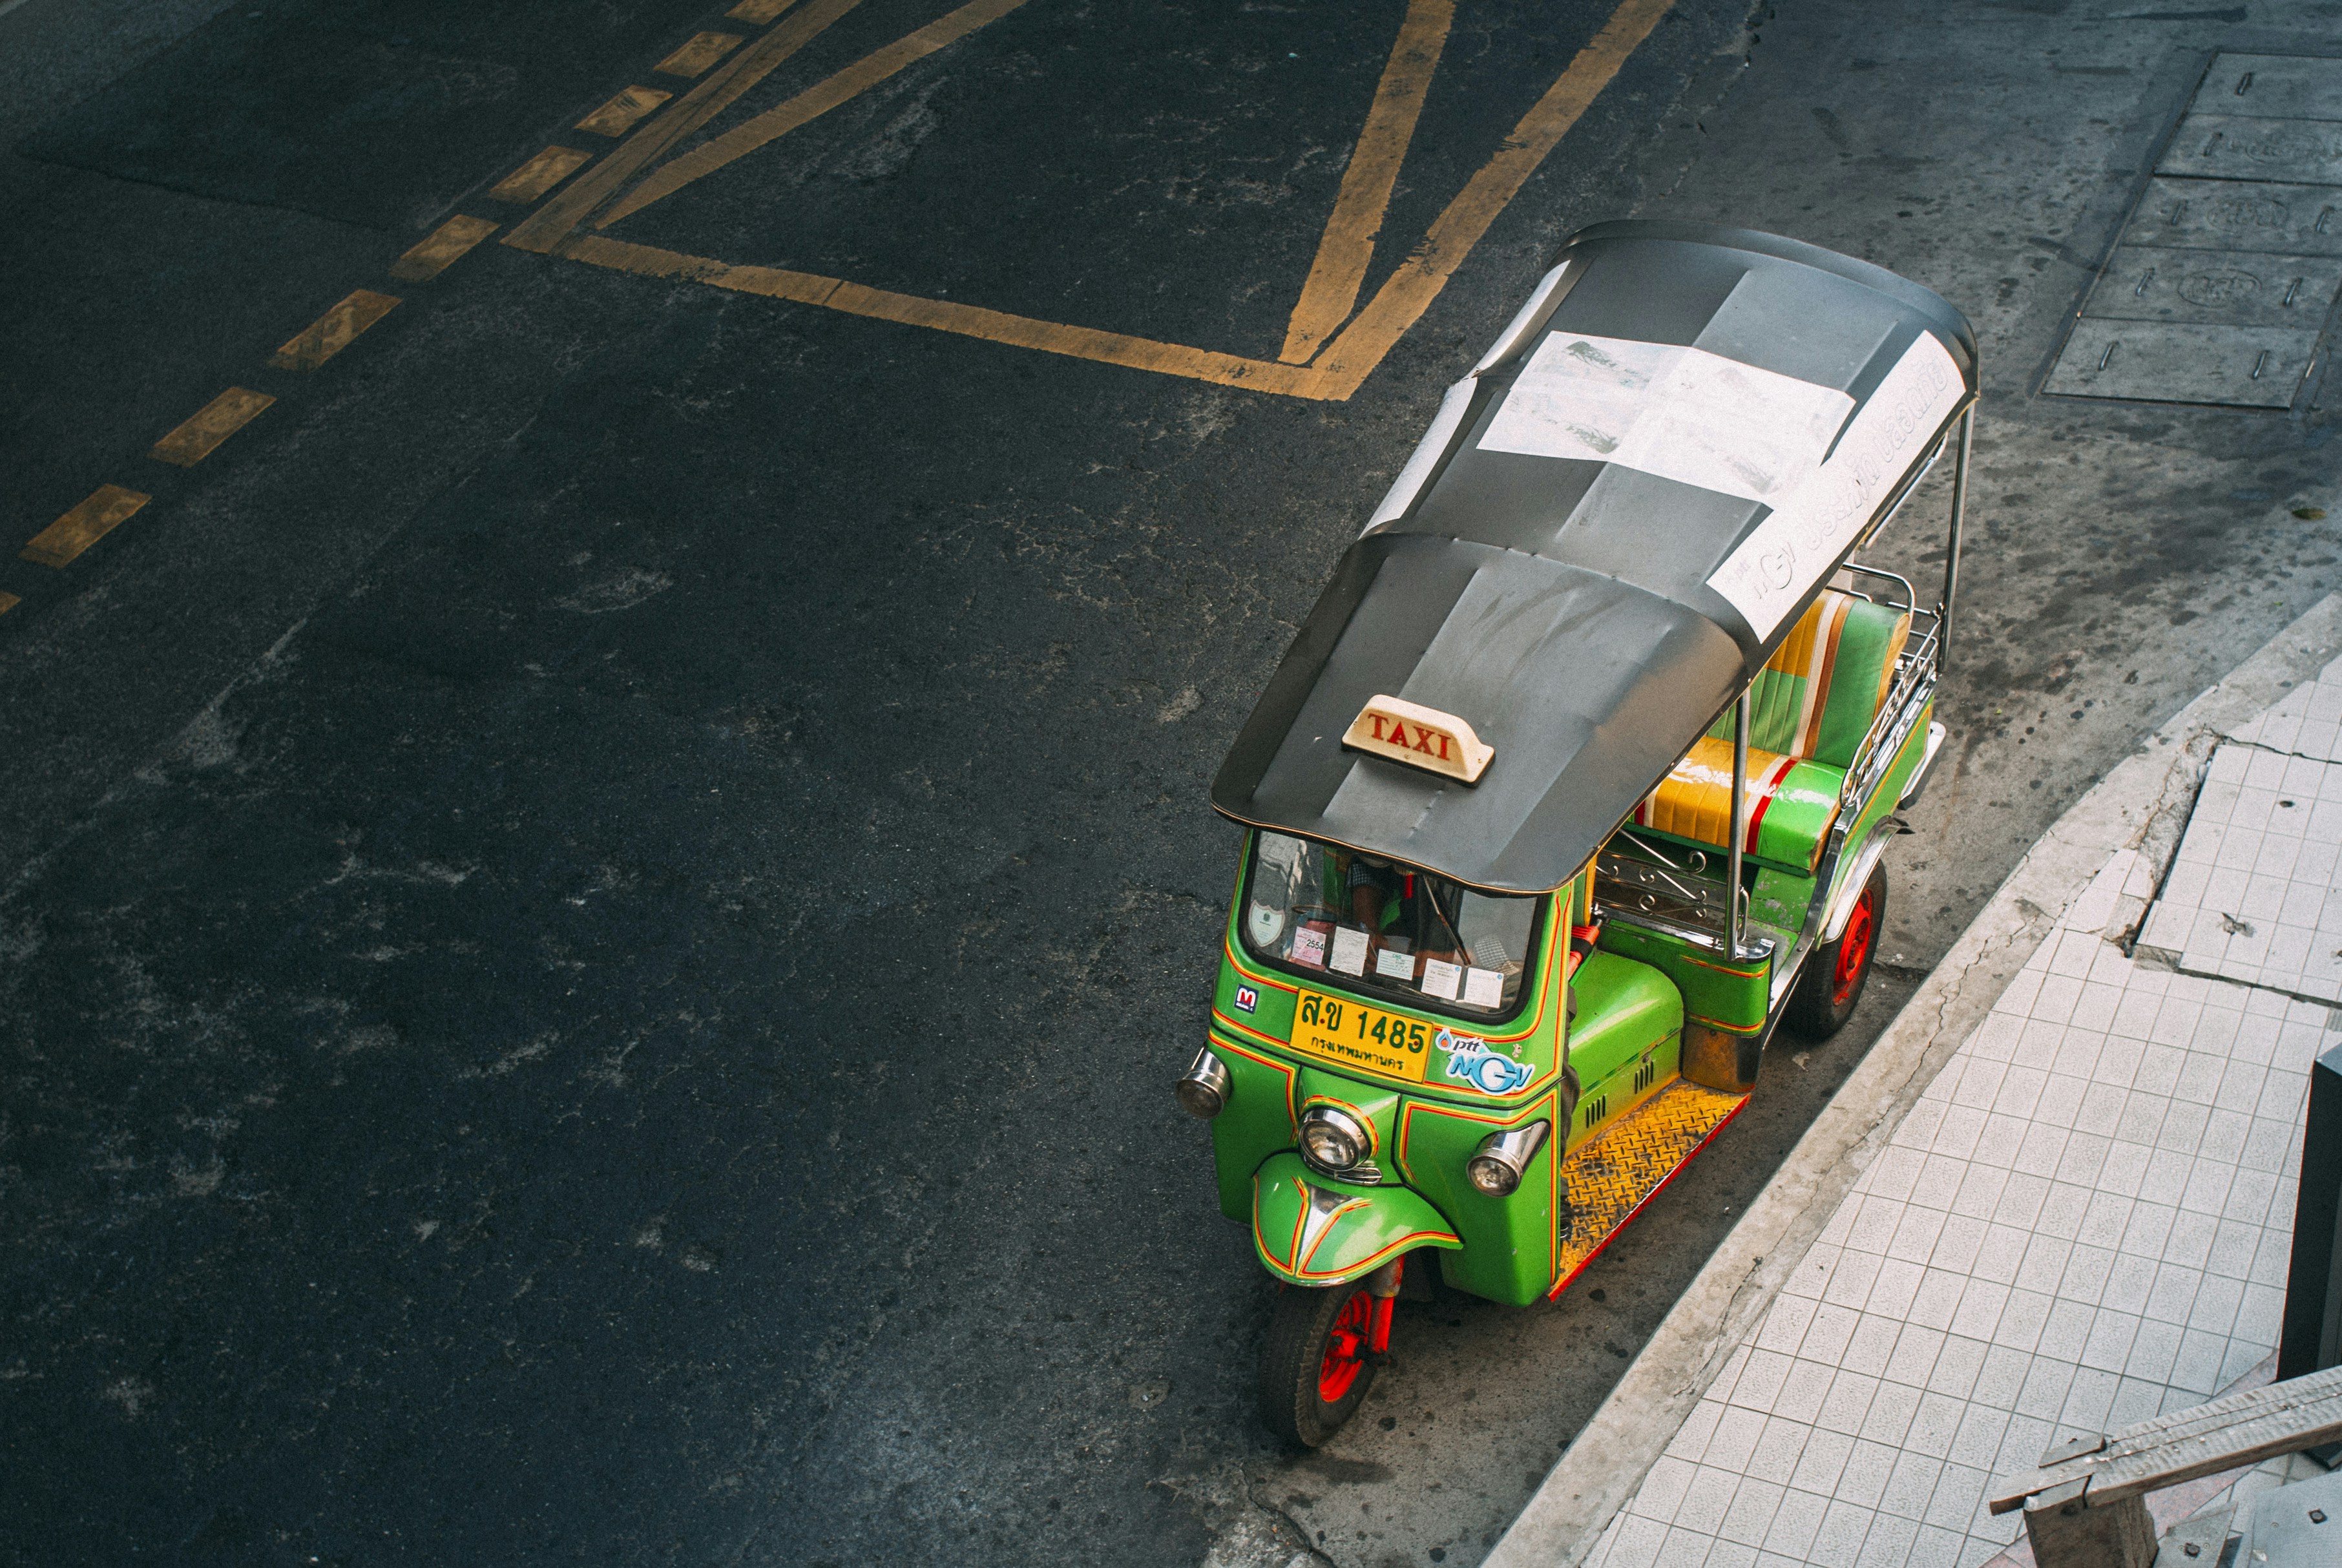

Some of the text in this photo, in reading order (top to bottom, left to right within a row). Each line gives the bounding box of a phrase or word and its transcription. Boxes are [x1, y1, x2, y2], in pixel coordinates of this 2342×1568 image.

[1368, 713, 1451, 761] TAXI
[1306, 939, 1324, 952] 2554
[1358, 1010, 1427, 1054] 1485
[1453, 1040, 1480, 1052] ptt
[1311, 1036, 1405, 1071] กรุงเทพมหานคร
[1450, 1054, 1532, 1092] NGV
